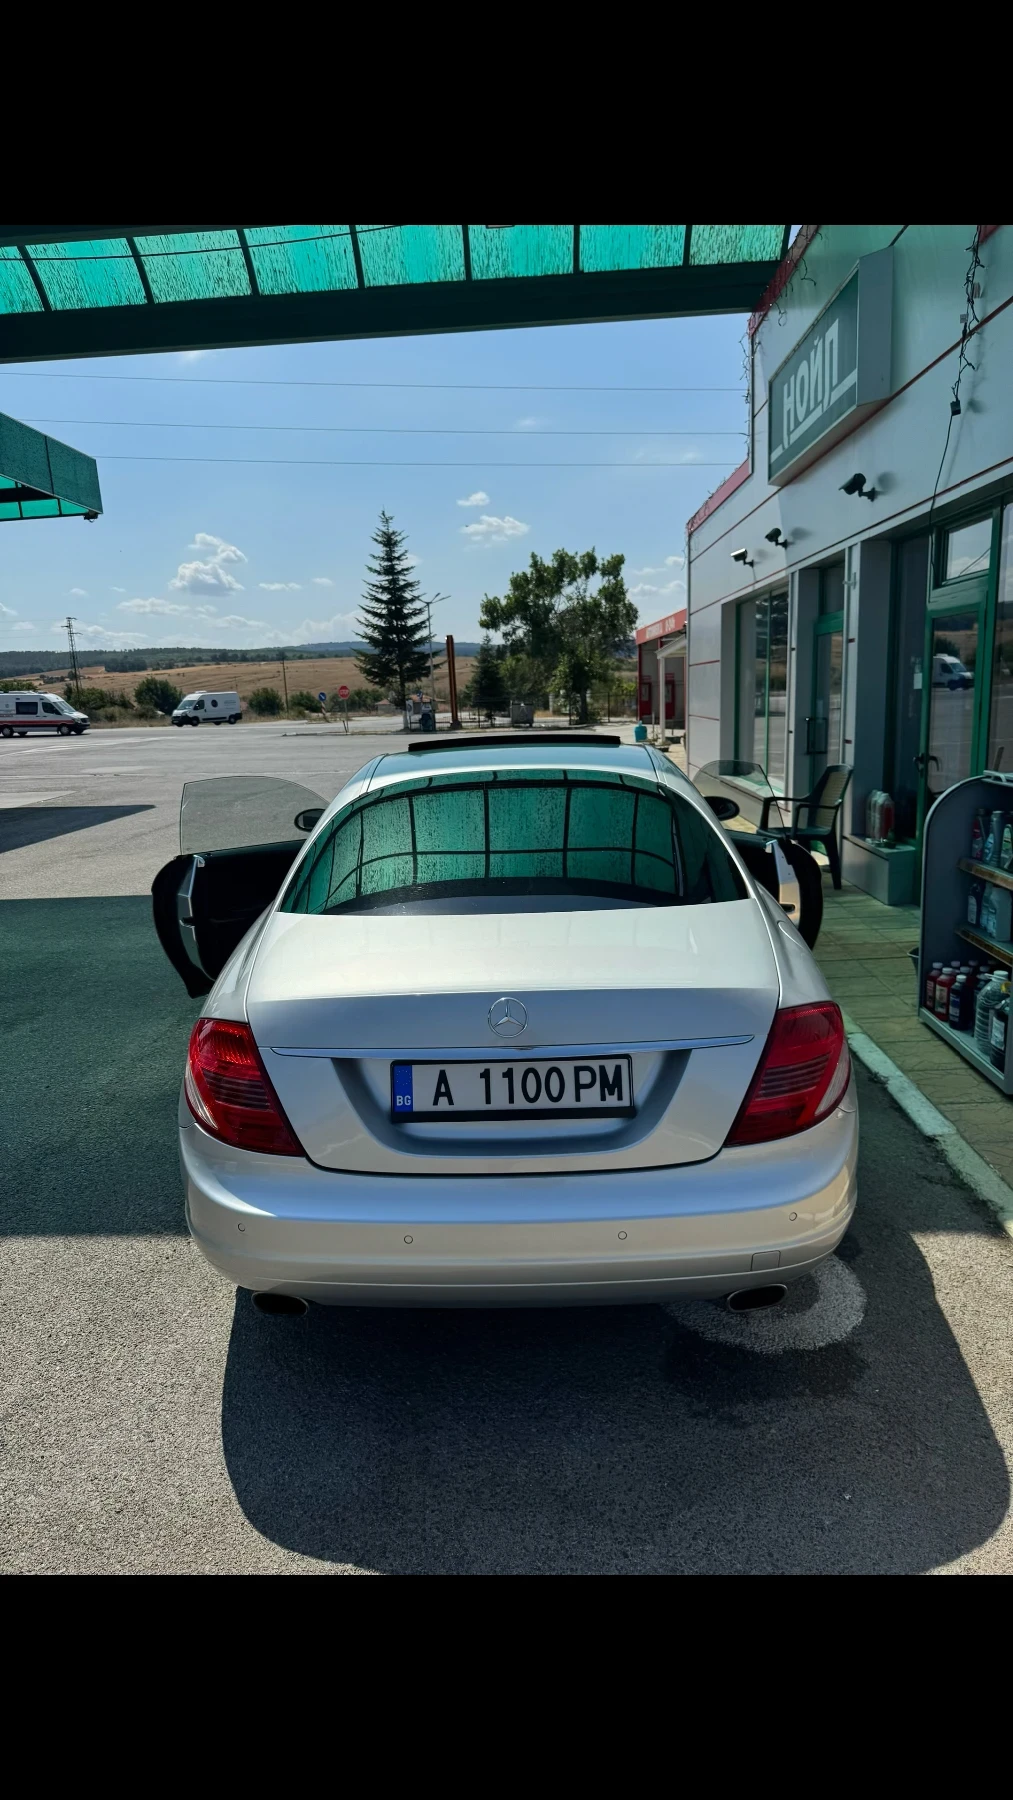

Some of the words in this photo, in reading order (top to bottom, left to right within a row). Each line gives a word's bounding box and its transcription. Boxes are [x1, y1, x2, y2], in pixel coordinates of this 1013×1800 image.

[783, 318, 839, 449] НОЙЛ
[396, 1095, 412, 1106] BG
[432, 1069, 454, 1106] A
[479, 1066, 566, 1105] 1100
[573, 1064, 624, 1103] PM
